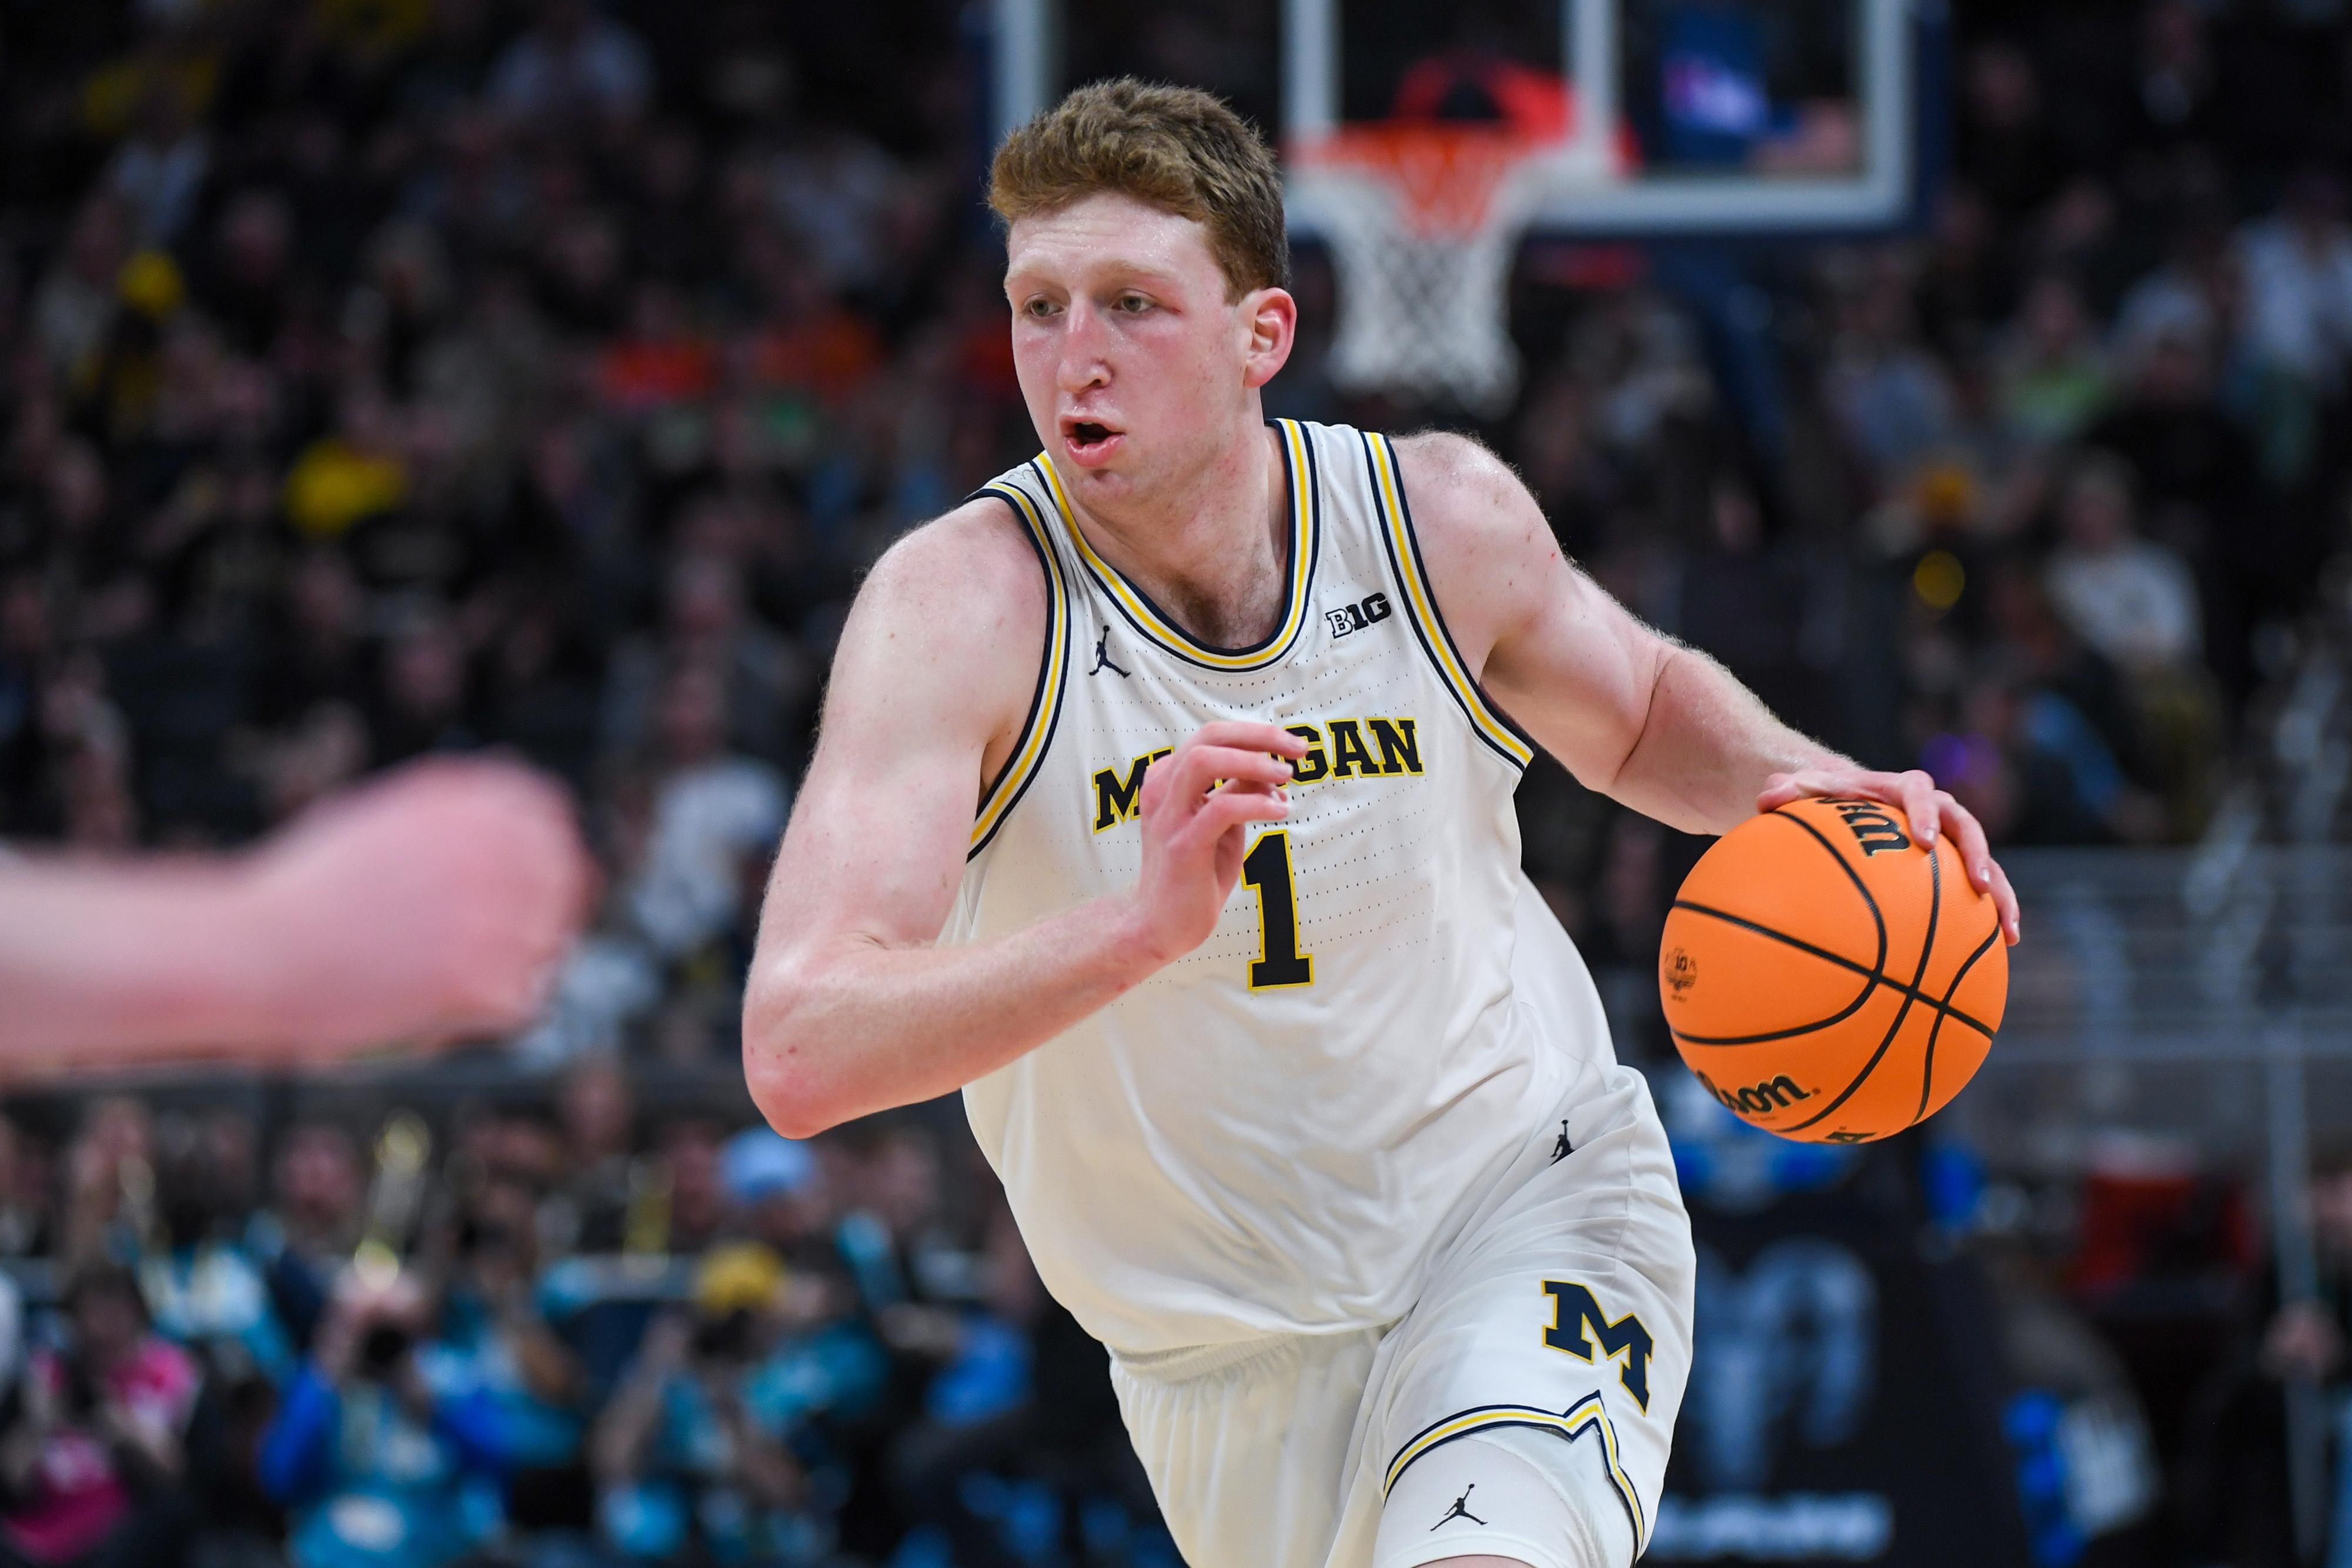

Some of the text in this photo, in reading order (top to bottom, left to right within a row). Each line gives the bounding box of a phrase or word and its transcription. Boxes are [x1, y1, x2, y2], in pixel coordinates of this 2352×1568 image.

[1092, 717, 1425, 835] MGAN
[1241, 829, 1314, 991] 1
[1541, 1279, 1653, 1416] M
